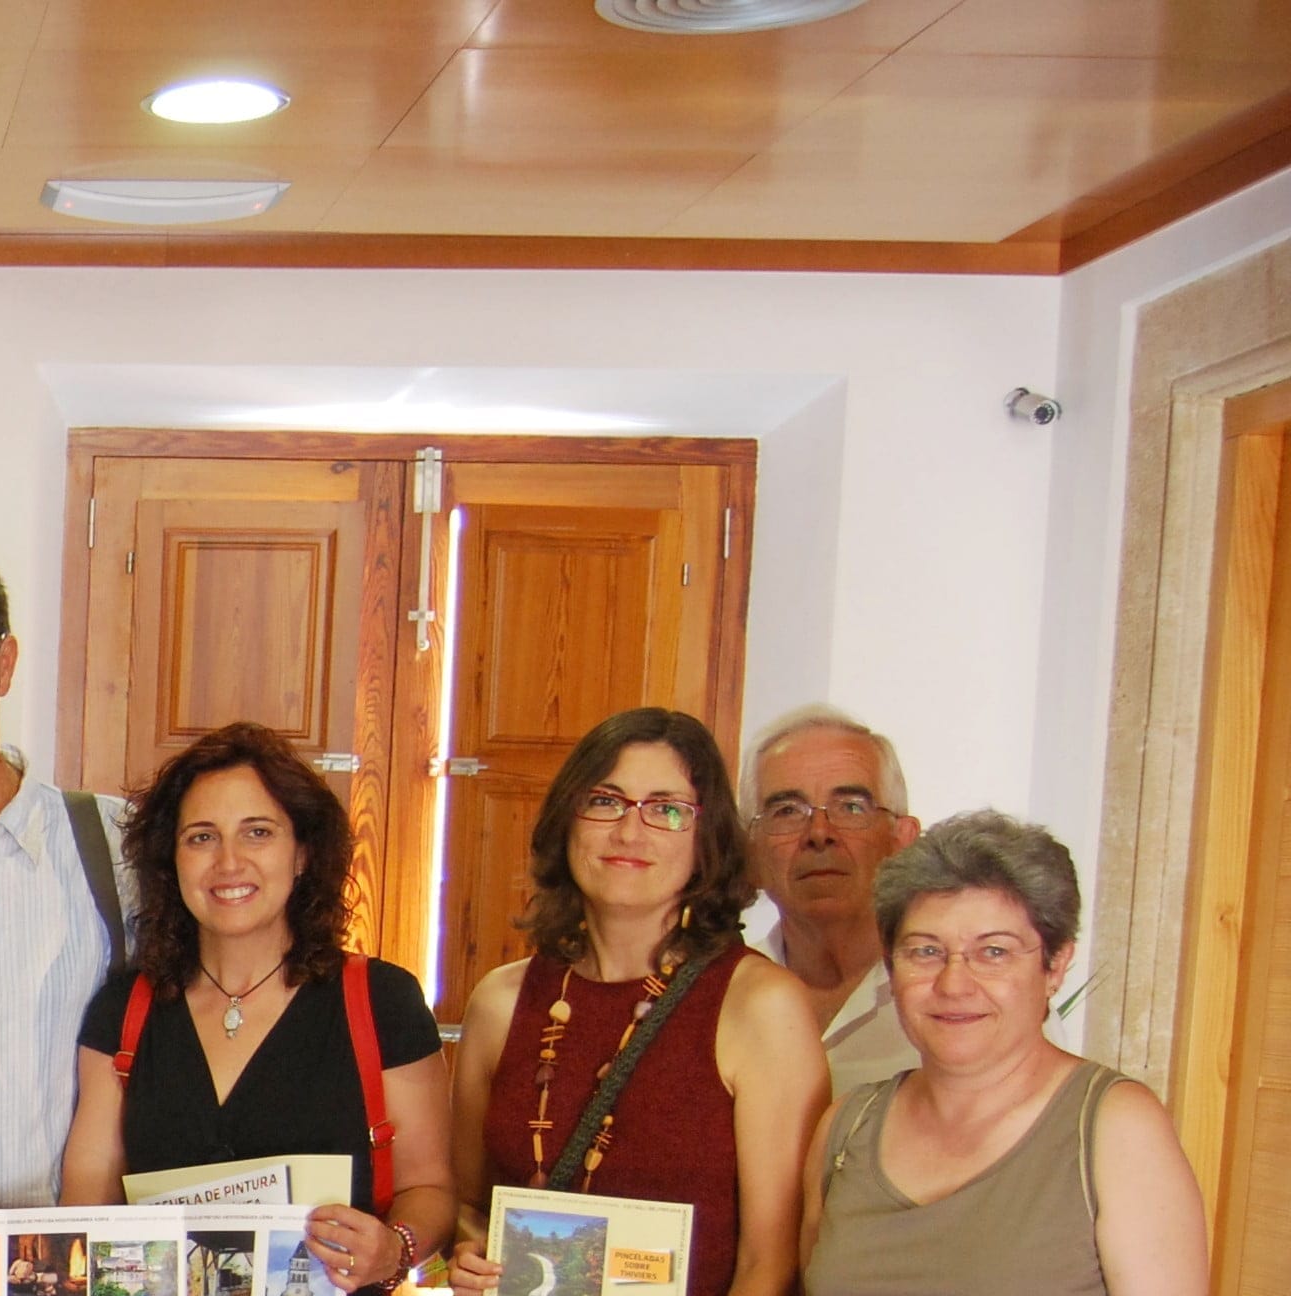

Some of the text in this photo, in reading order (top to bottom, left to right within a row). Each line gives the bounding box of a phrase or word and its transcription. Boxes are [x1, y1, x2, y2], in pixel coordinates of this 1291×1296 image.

[205, 1188, 221, 1203] DE
[223, 1174, 278, 1197] PINTURA
[614, 1251, 665, 1264] PINCELADAS
[624, 1261, 650, 1270] SOBRE
